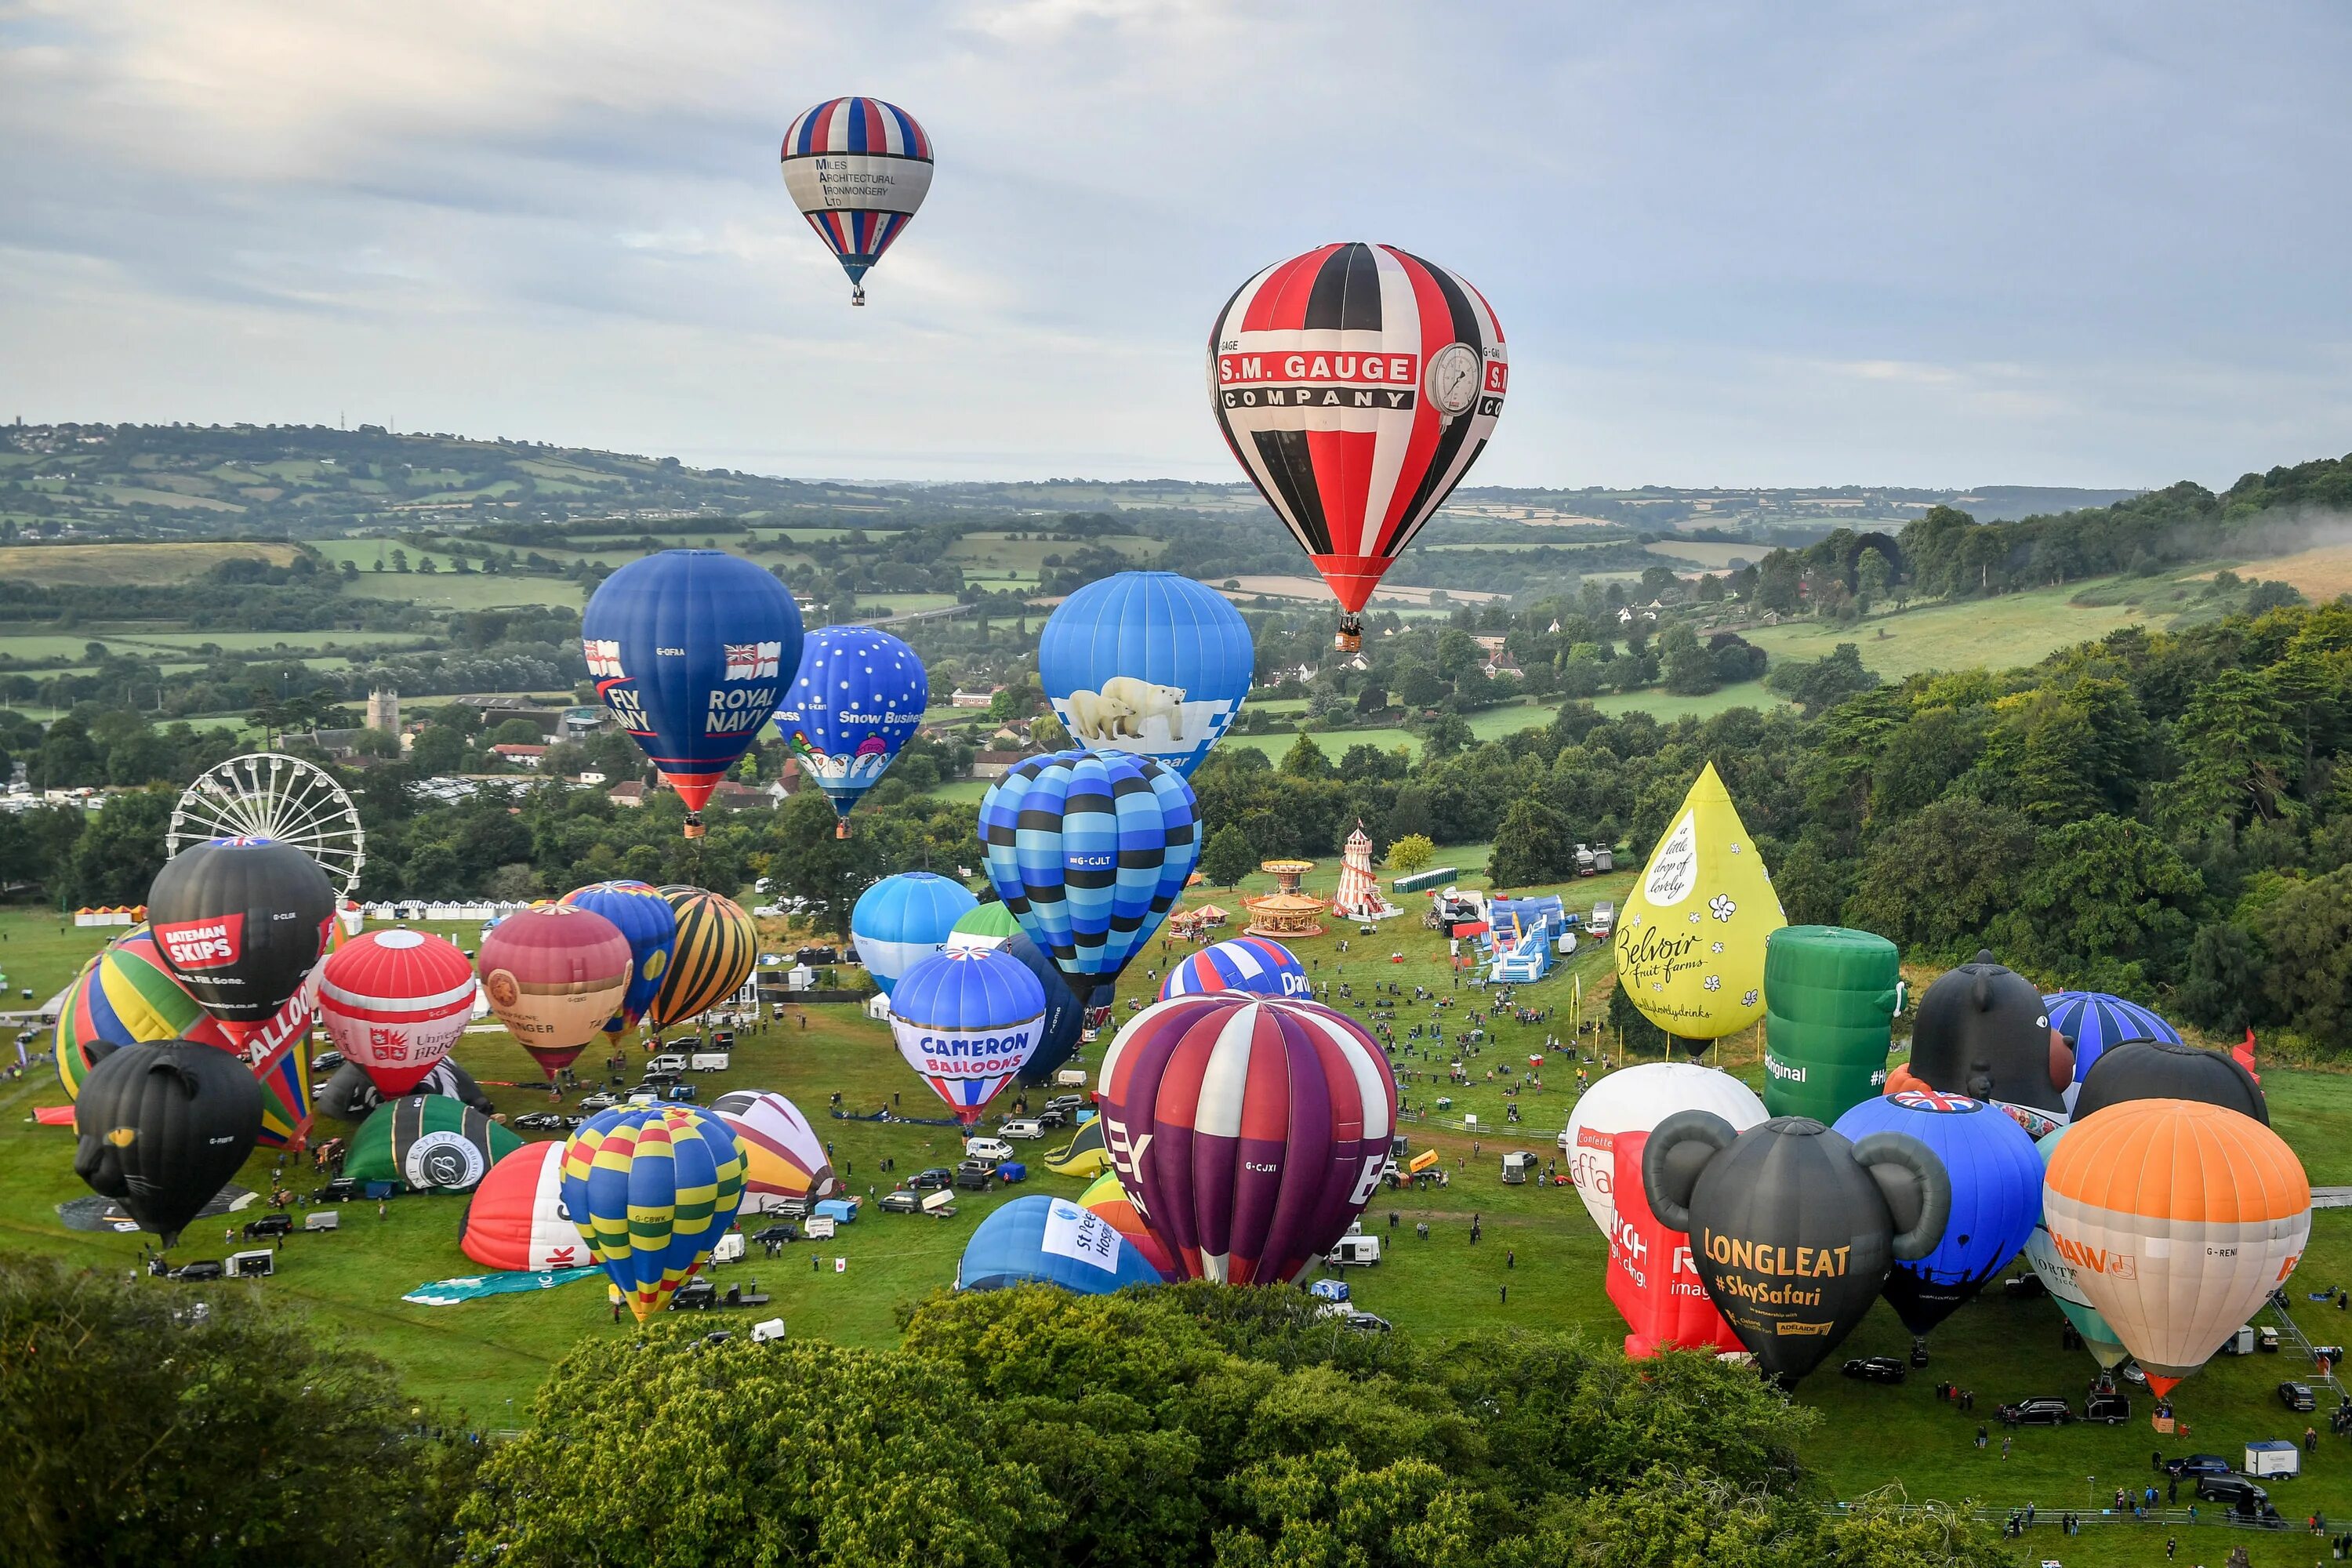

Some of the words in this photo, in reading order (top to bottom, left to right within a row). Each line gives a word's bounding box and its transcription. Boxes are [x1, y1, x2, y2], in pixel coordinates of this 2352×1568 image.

[816, 158, 847, 170] MILES
[819, 172, 895, 184] ARCHITECTURAL
[823, 184, 888, 195] IRONMONGERY
[825, 196, 842, 206] LTD
[1221, 357, 1272, 381] S.M.
[1284, 355, 1409, 380] GAUGE
[1225, 390, 1405, 407] COMPANY
[608, 688, 640, 710] FLY
[709, 688, 777, 710] ROYAL
[706, 707, 769, 732] NAVY
[839, 711, 882, 724] Snow
[1666, 839, 1688, 855] little
[1077, 856, 1111, 866] G-CJLT
[1653, 859, 1676, 880] drop
[1676, 852, 1693, 874] of
[1648, 877, 1685, 899] lovely
[165, 924, 227, 944] BATEMAN
[169, 938, 232, 963] SKIPS
[1615, 925, 1703, 975] Belvoir
[1629, 963, 1663, 989] fruit
[1662, 957, 1708, 984] farms
[248, 985, 310, 1068] ALLOO
[920, 1032, 1029, 1057] CAMERON
[926, 1054, 1022, 1073] BALLOONS
[1245, 1161, 1276, 1172] G-CJXI
[1704, 1226, 1850, 1278] LONGLEAT
[2206, 1247, 2238, 1258] G-RENI
[1715, 1274, 1821, 1307] #SkySafari
